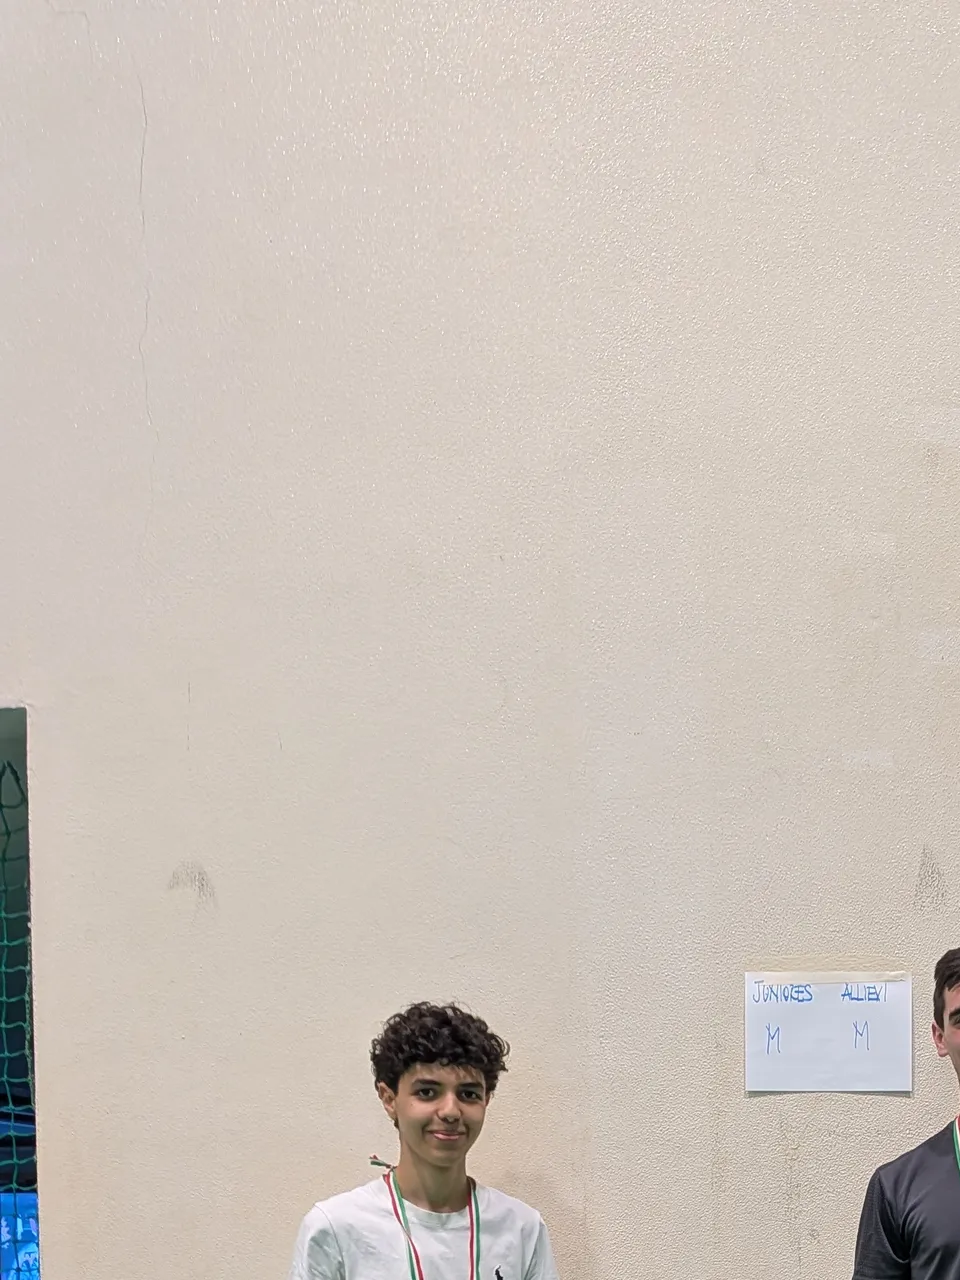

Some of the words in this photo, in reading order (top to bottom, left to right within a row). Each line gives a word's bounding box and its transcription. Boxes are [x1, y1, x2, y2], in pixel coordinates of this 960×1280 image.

[752, 980, 813, 1003] JUNIORES
[840, 982, 888, 1003] ALLIEVI
[765, 1023, 781, 1055] M
[852, 1020, 870, 1051] M
